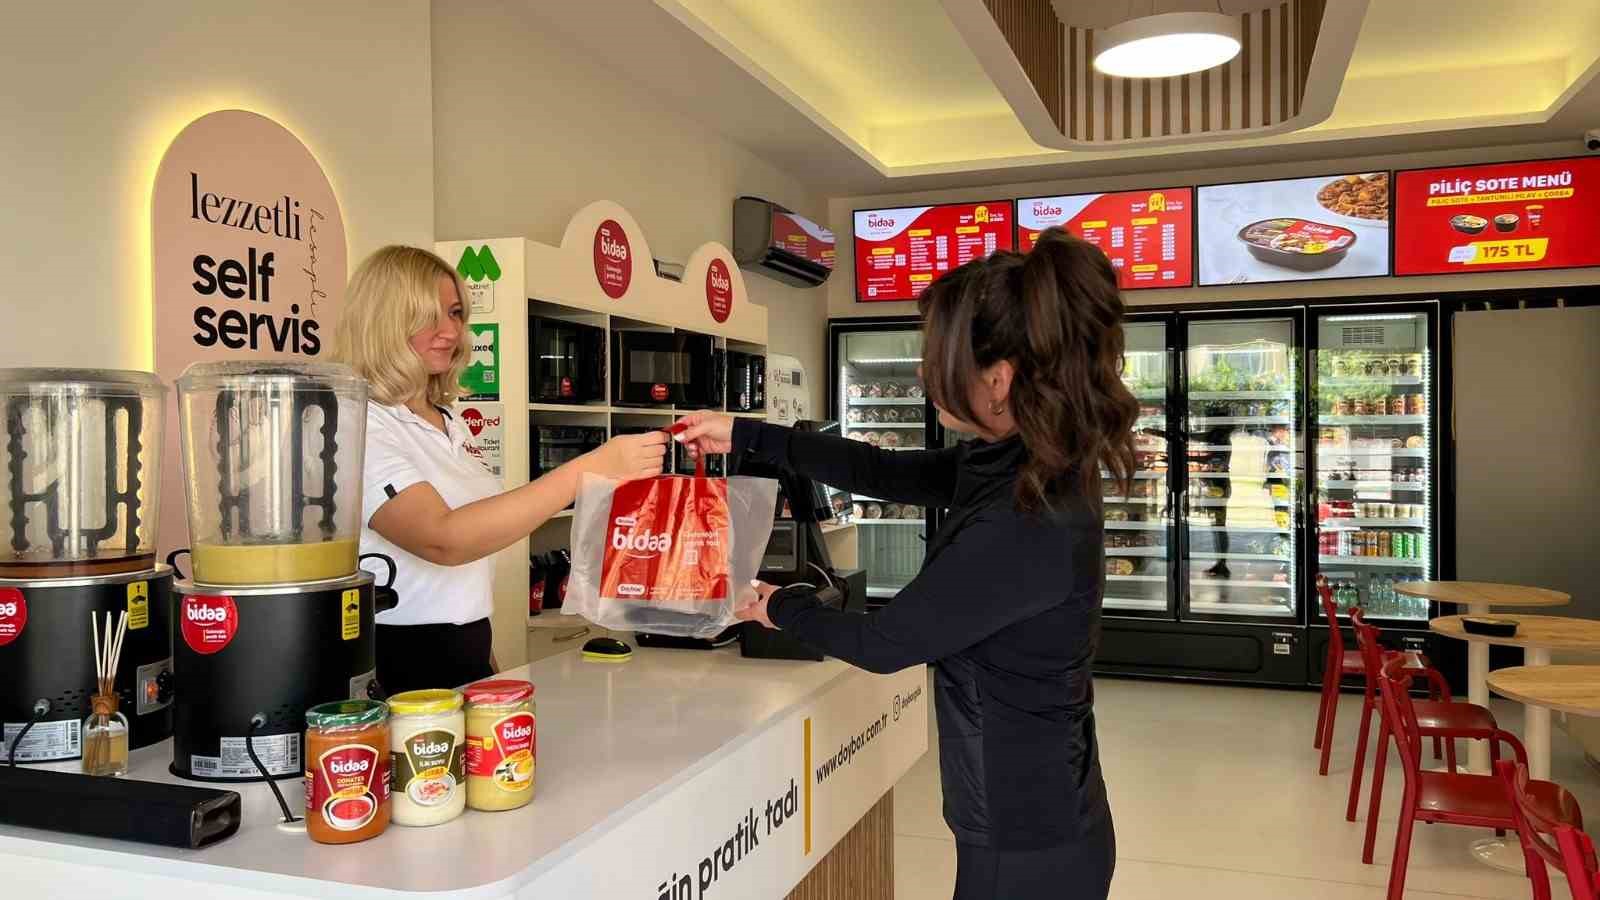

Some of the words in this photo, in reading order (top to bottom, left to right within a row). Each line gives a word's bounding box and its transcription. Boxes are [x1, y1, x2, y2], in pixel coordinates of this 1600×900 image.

[1429, 180, 1472, 195] PİLİÇ
[1475, 177, 1518, 191] SOTE
[1522, 171, 1572, 188] MENÜ
[190, 171, 301, 241] lezzetli
[1033, 206, 1062, 217] bidaa
[868, 217, 895, 228] bidaa
[601, 236, 627, 260] bidaa
[1483, 245, 1510, 258] 175
[1514, 244, 1535, 256] TL
[191, 247, 275, 302] self
[711, 272, 729, 291] bidaa
[192, 303, 321, 356] servis
[465, 415, 500, 427] denred
[612, 527, 672, 553] bidaa
[187, 603, 227, 622] bidaa
[503, 726, 531, 740] bidaa
[413, 742, 449, 755] bidaa
[816, 713, 888, 784] www.doybox.com.tr
[330, 760, 369, 773] bidaa
[698, 808, 759, 900] pratik
[765, 778, 798, 835] tadı
